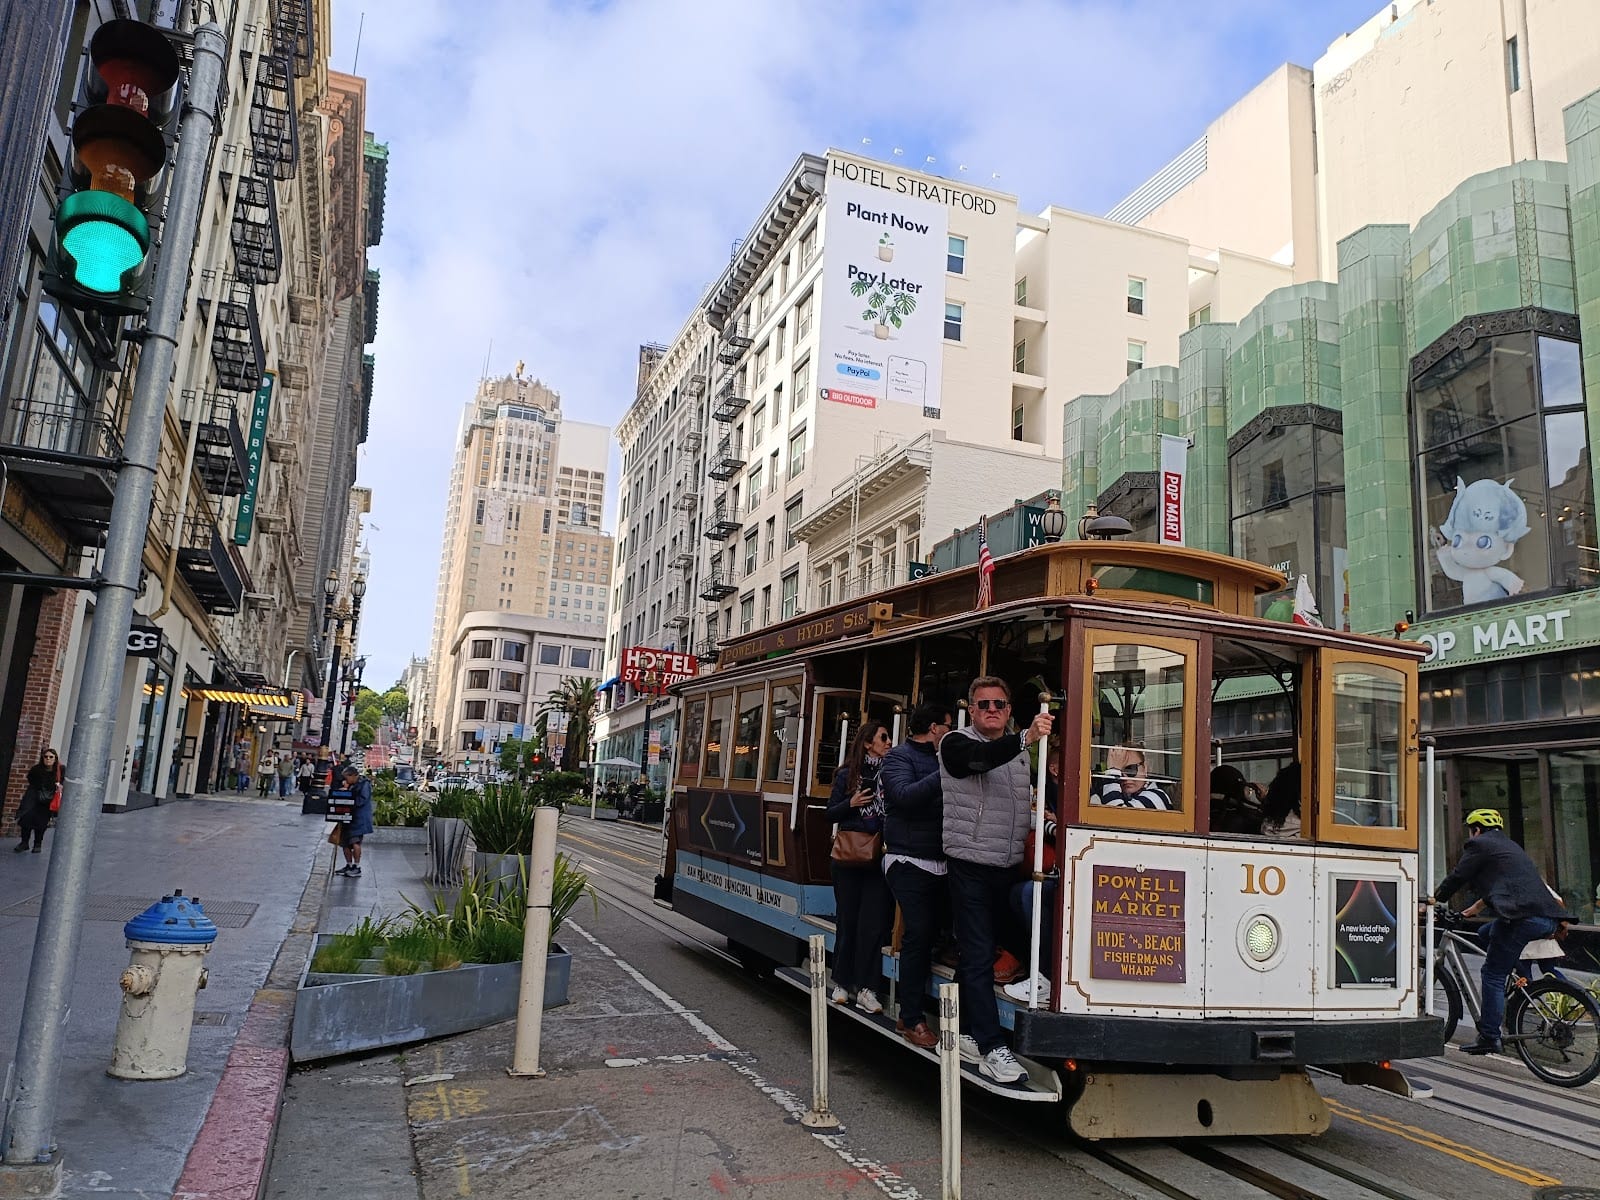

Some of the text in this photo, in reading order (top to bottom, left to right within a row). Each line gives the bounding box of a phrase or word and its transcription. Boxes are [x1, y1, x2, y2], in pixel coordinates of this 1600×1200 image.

[832, 159, 997, 215] HOTEL STRATFORD
[846, 201, 929, 235] Plant Now
[847, 263, 923, 294] Pay Later
[847, 365, 871, 377] PayPal
[831, 391, 874, 406] BIG OUTDOOR
[241, 395, 267, 514] THE BARNES
[1166, 474, 1179, 539] POP MART
[127, 630, 158, 651] GG
[724, 640, 767, 662] POWELL
[776, 634, 785, 648] &
[797, 618, 836, 642] HYDE
[1417, 608, 1571, 664] OP MART
[687, 865, 697, 878] SAN
[696, 868, 723, 887] FRANCISCO
[756, 887, 782, 908] RAILWAY
[1097, 874, 1180, 893] POWELL
[1240, 863, 1286, 896] 10
[1119, 890, 1160, 903] AND
[1095, 899, 1181, 918] MARKET
[1340, 924, 1390, 934] A new kind of help
[1348, 933, 1384, 944] from Google
[1096, 931, 1181, 952] HYDE AND BEACH
[1104, 951, 1174, 967] FISHERMANS
[1120, 964, 1157, 977] WHARF
